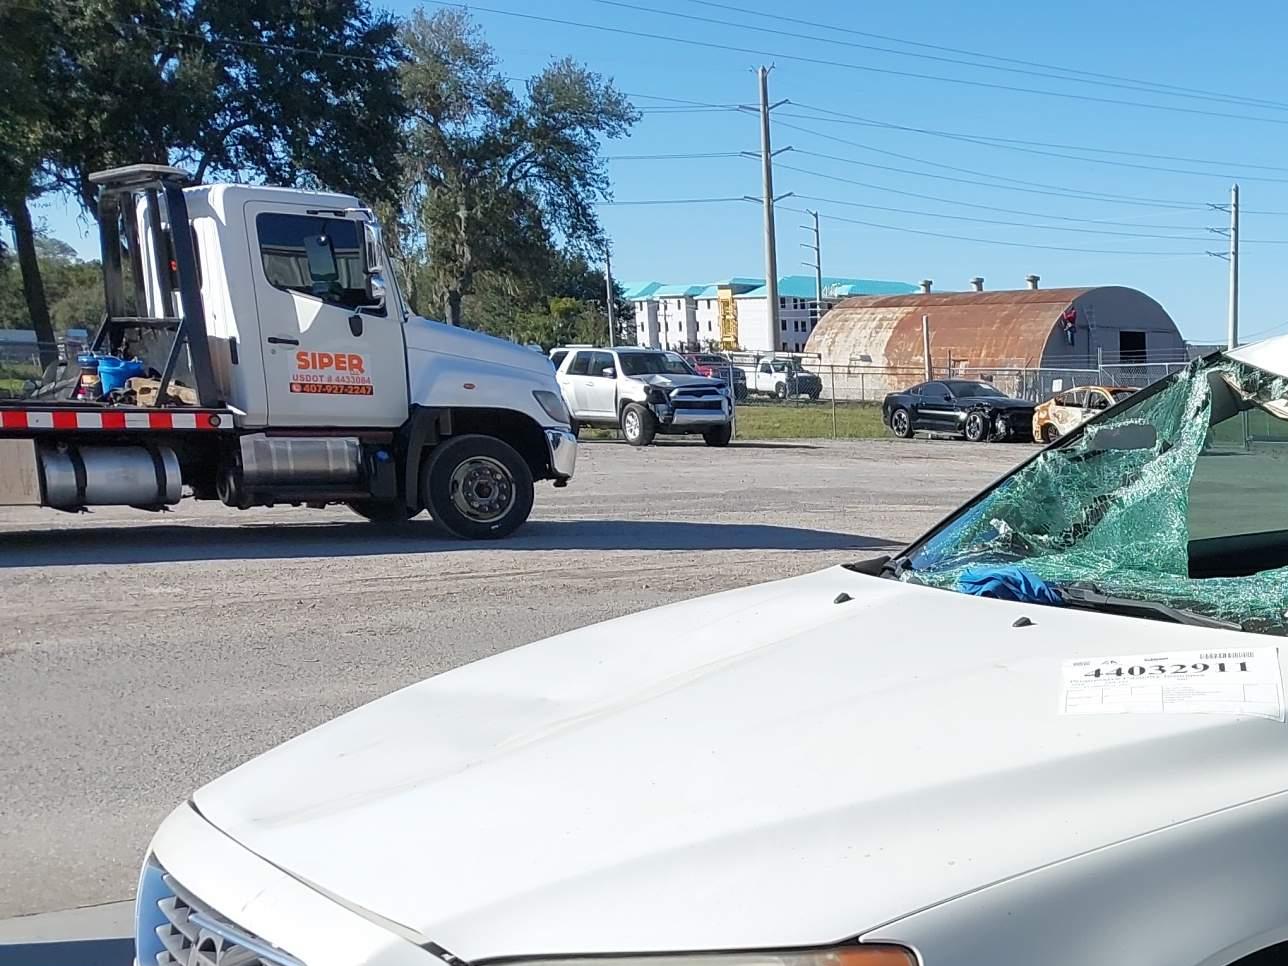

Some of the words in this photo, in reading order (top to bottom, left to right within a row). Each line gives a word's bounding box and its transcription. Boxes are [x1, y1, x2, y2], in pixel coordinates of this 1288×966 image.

[296, 351, 365, 374] SIPER
[292, 374, 324, 383] USDOT
[327, 375, 333, 383] #
[303, 384, 372, 394] 407-927-2247
[1084, 661, 1248, 679] 44032911
